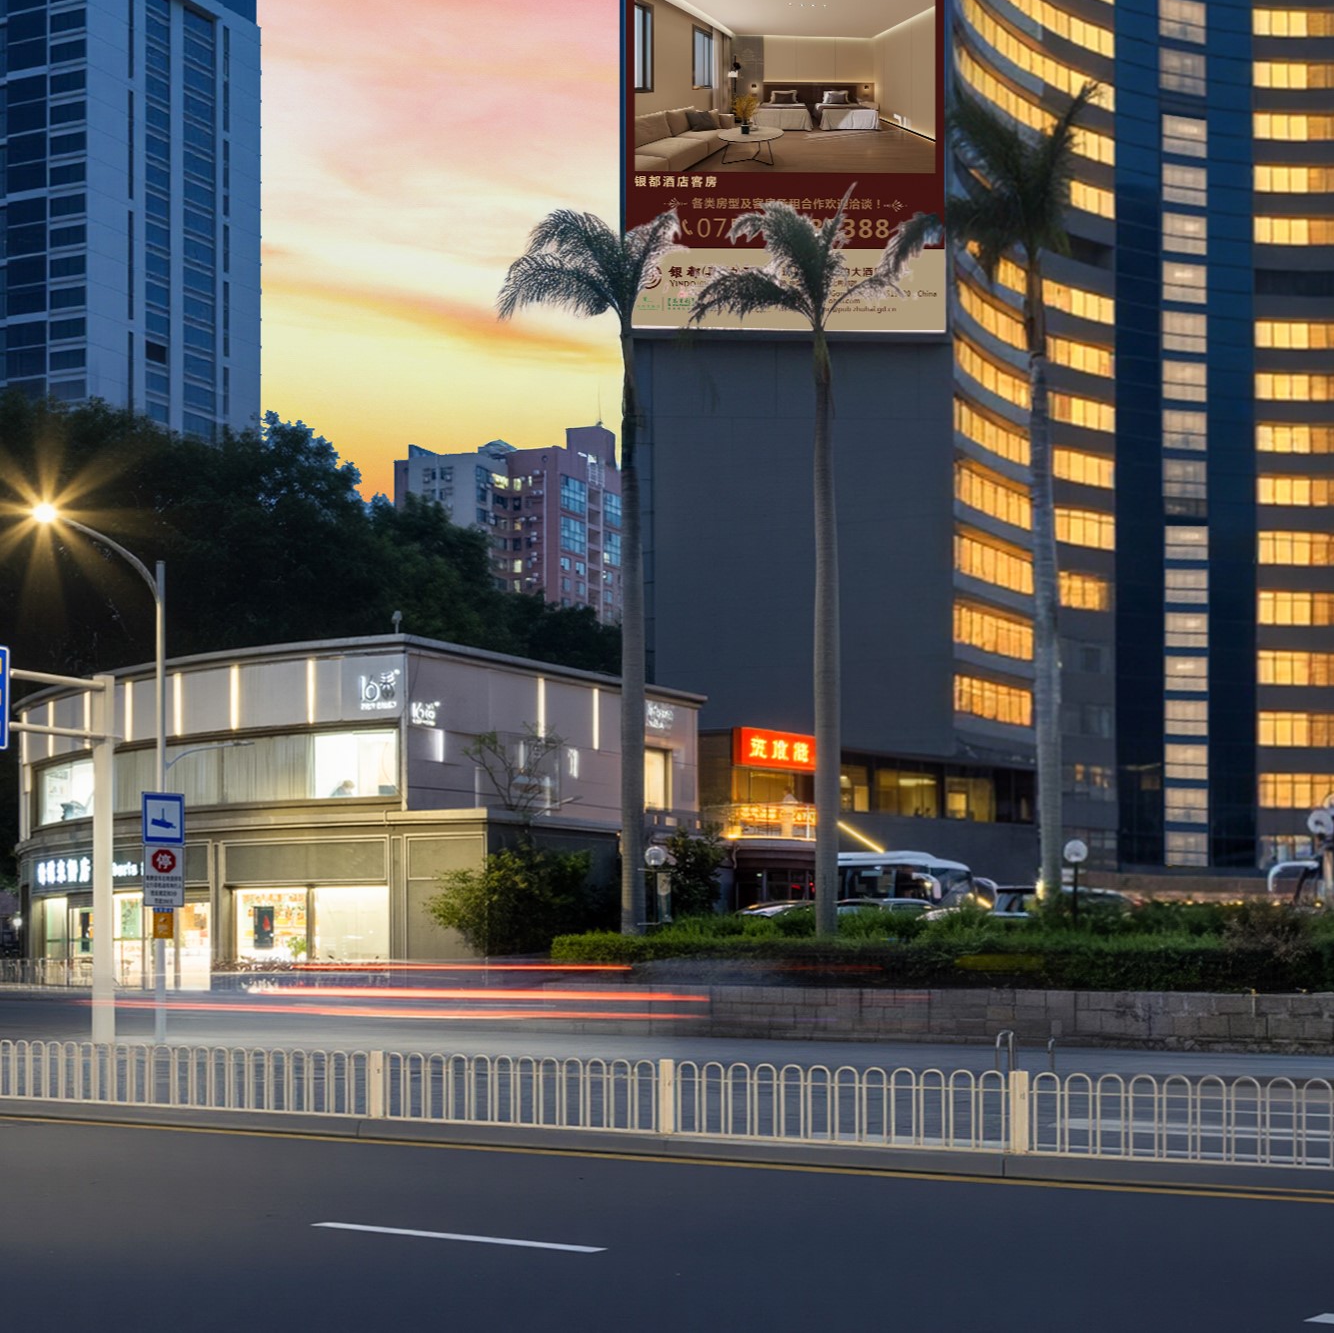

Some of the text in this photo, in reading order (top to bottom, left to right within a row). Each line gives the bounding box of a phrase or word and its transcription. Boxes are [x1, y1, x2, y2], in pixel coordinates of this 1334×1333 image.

[634, 175, 717, 188] 银都酒店客房
